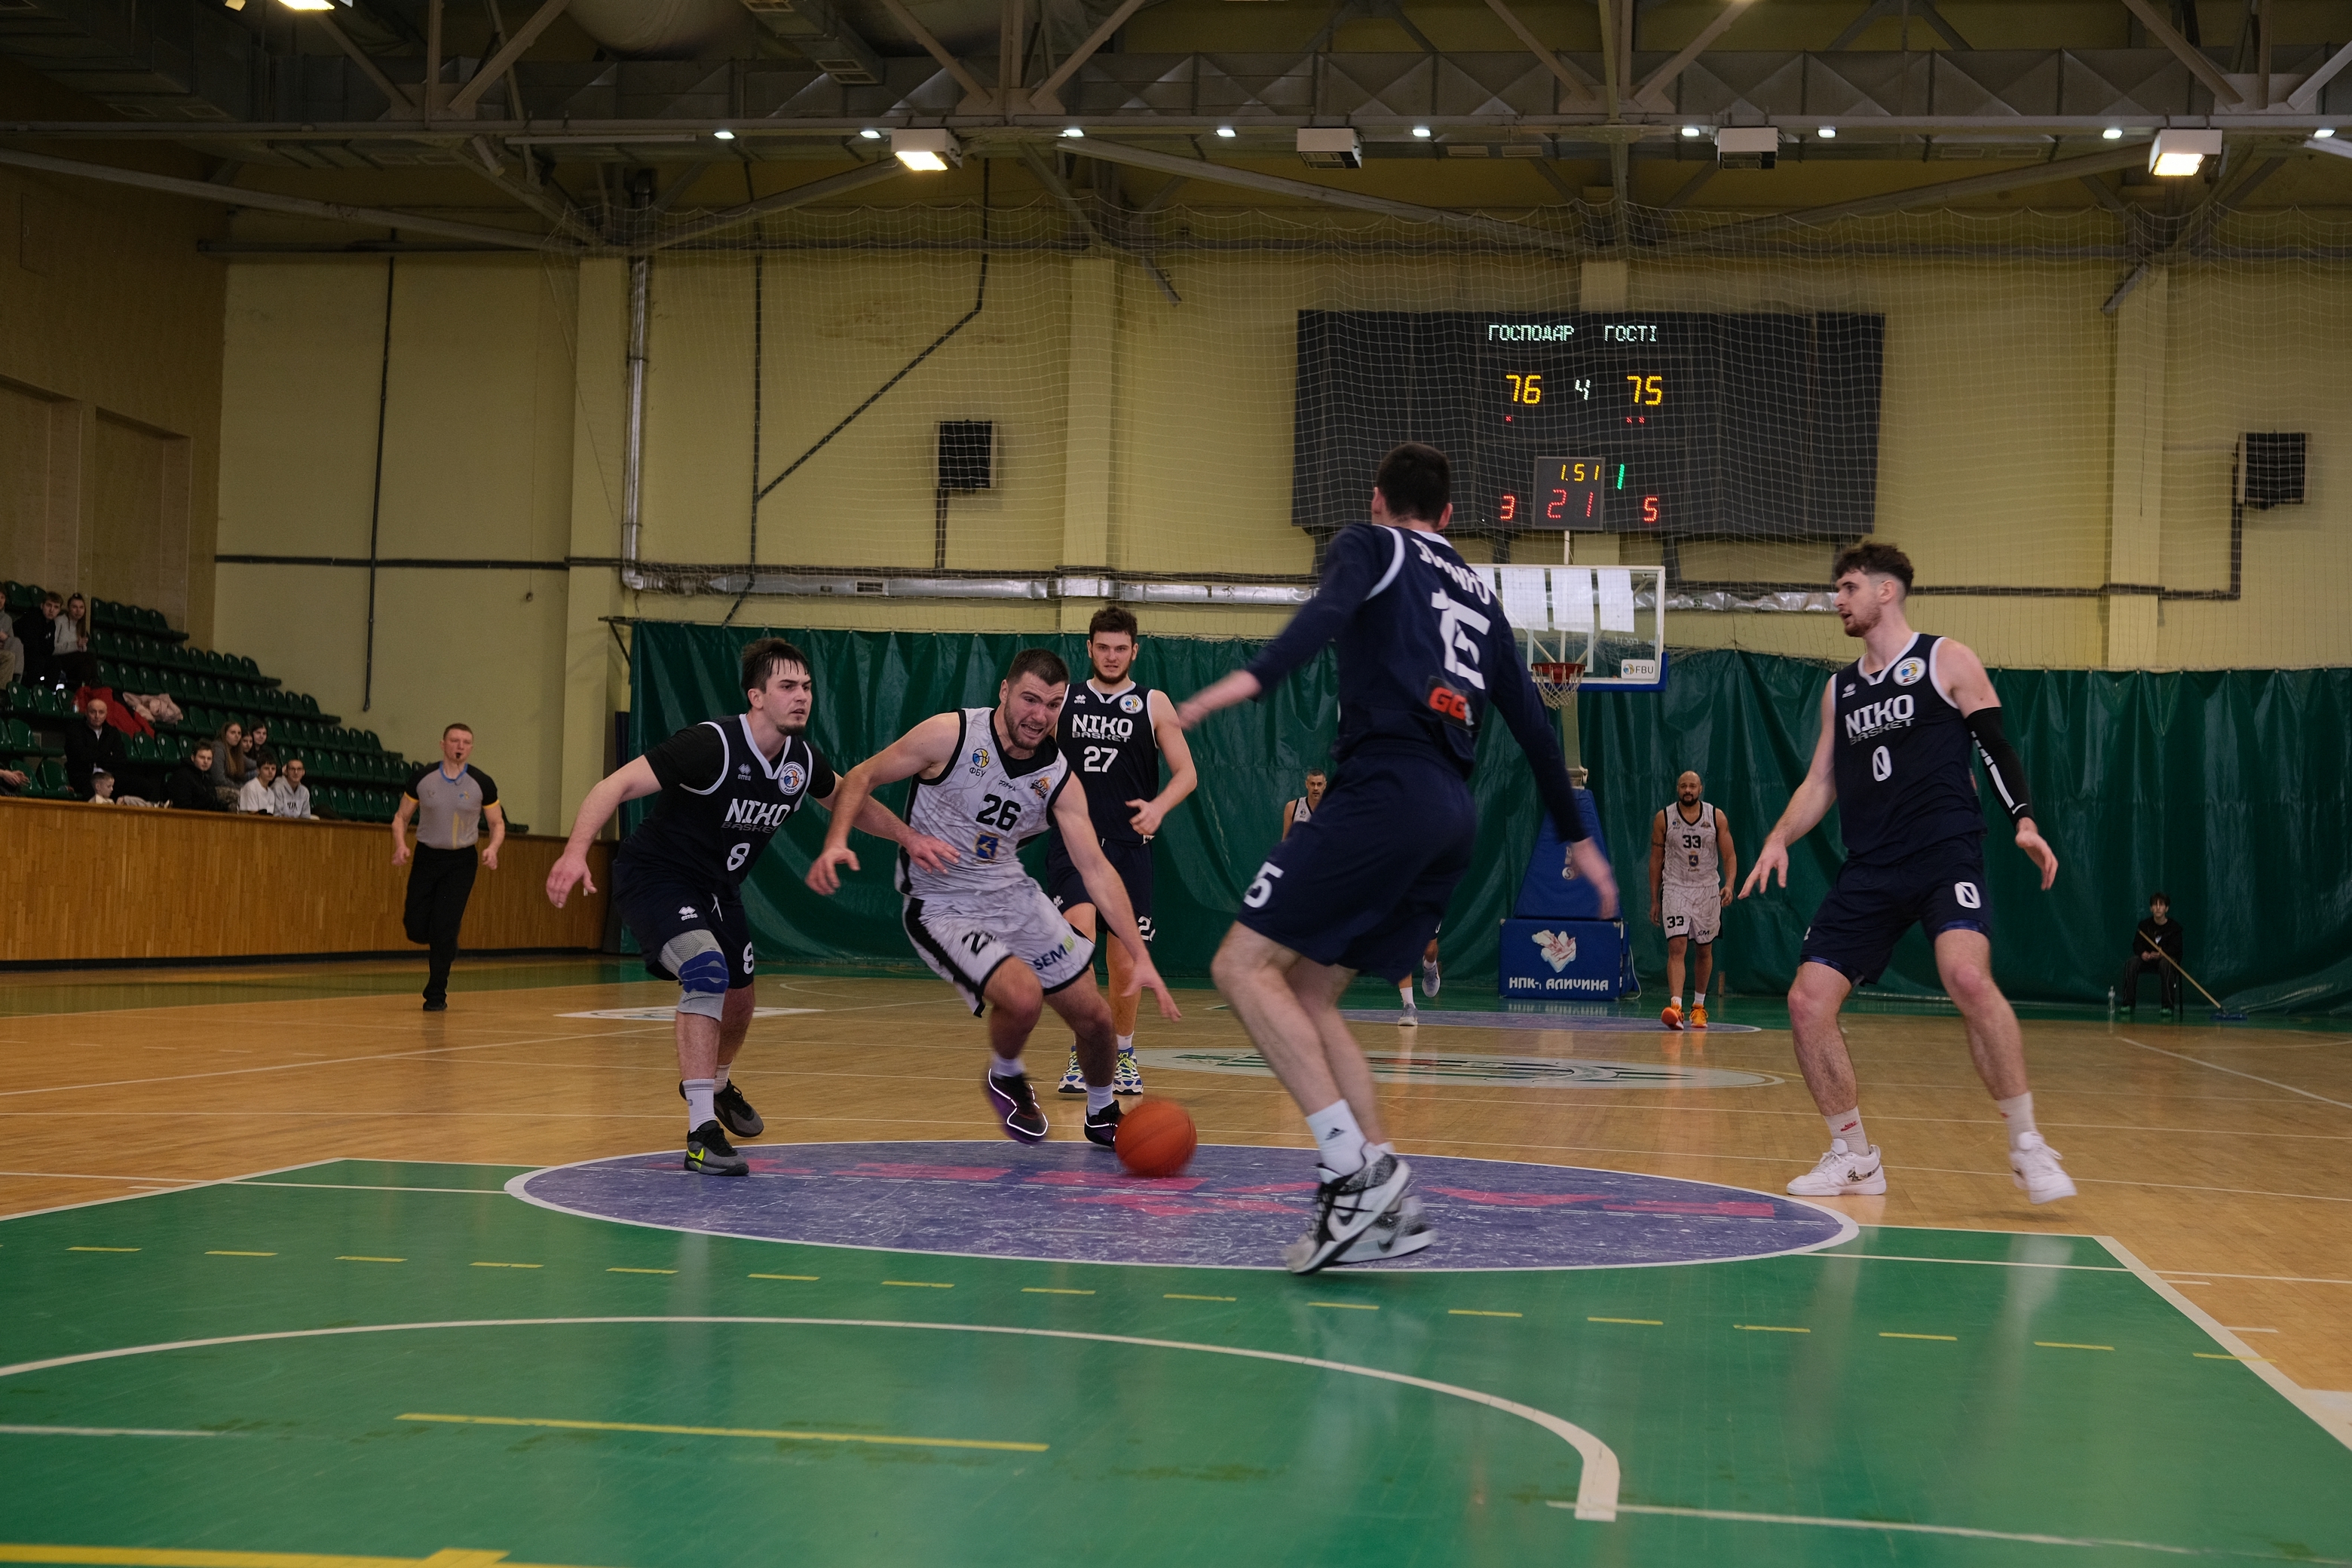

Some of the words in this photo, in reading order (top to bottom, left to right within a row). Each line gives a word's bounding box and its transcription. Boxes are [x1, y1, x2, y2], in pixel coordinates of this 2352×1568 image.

[1488, 324, 1575, 341] ГОСПОДАР
[1604, 325, 1658, 341] ГОСТІ
[1506, 375, 1542, 404] 76
[1575, 378, 1591, 401] 4
[1627, 375, 1662, 405] 75
[1500, 495, 1515, 520] 3
[1643, 496, 1658, 522] 5
[1635, 666, 1654, 674] FBU
[1072, 713, 1134, 737] NIKO
[1845, 694, 1915, 739] NIKO
[1071, 730, 1131, 743] BASKET
[1850, 717, 1916, 746] BASKET
[969, 767, 987, 778] ФБУ
[1083, 745, 1119, 773] 27
[1872, 745, 1893, 782] 0
[724, 798, 791, 827] NIKO
[975, 793, 1021, 831] 26
[721, 822, 778, 834] BASKE
[1682, 834, 1701, 849] 33
[726, 842, 751, 871] 8
[1954, 881, 1981, 909] 0
[1667, 915, 1684, 929] 33
[1033, 943, 1068, 970] SEM
